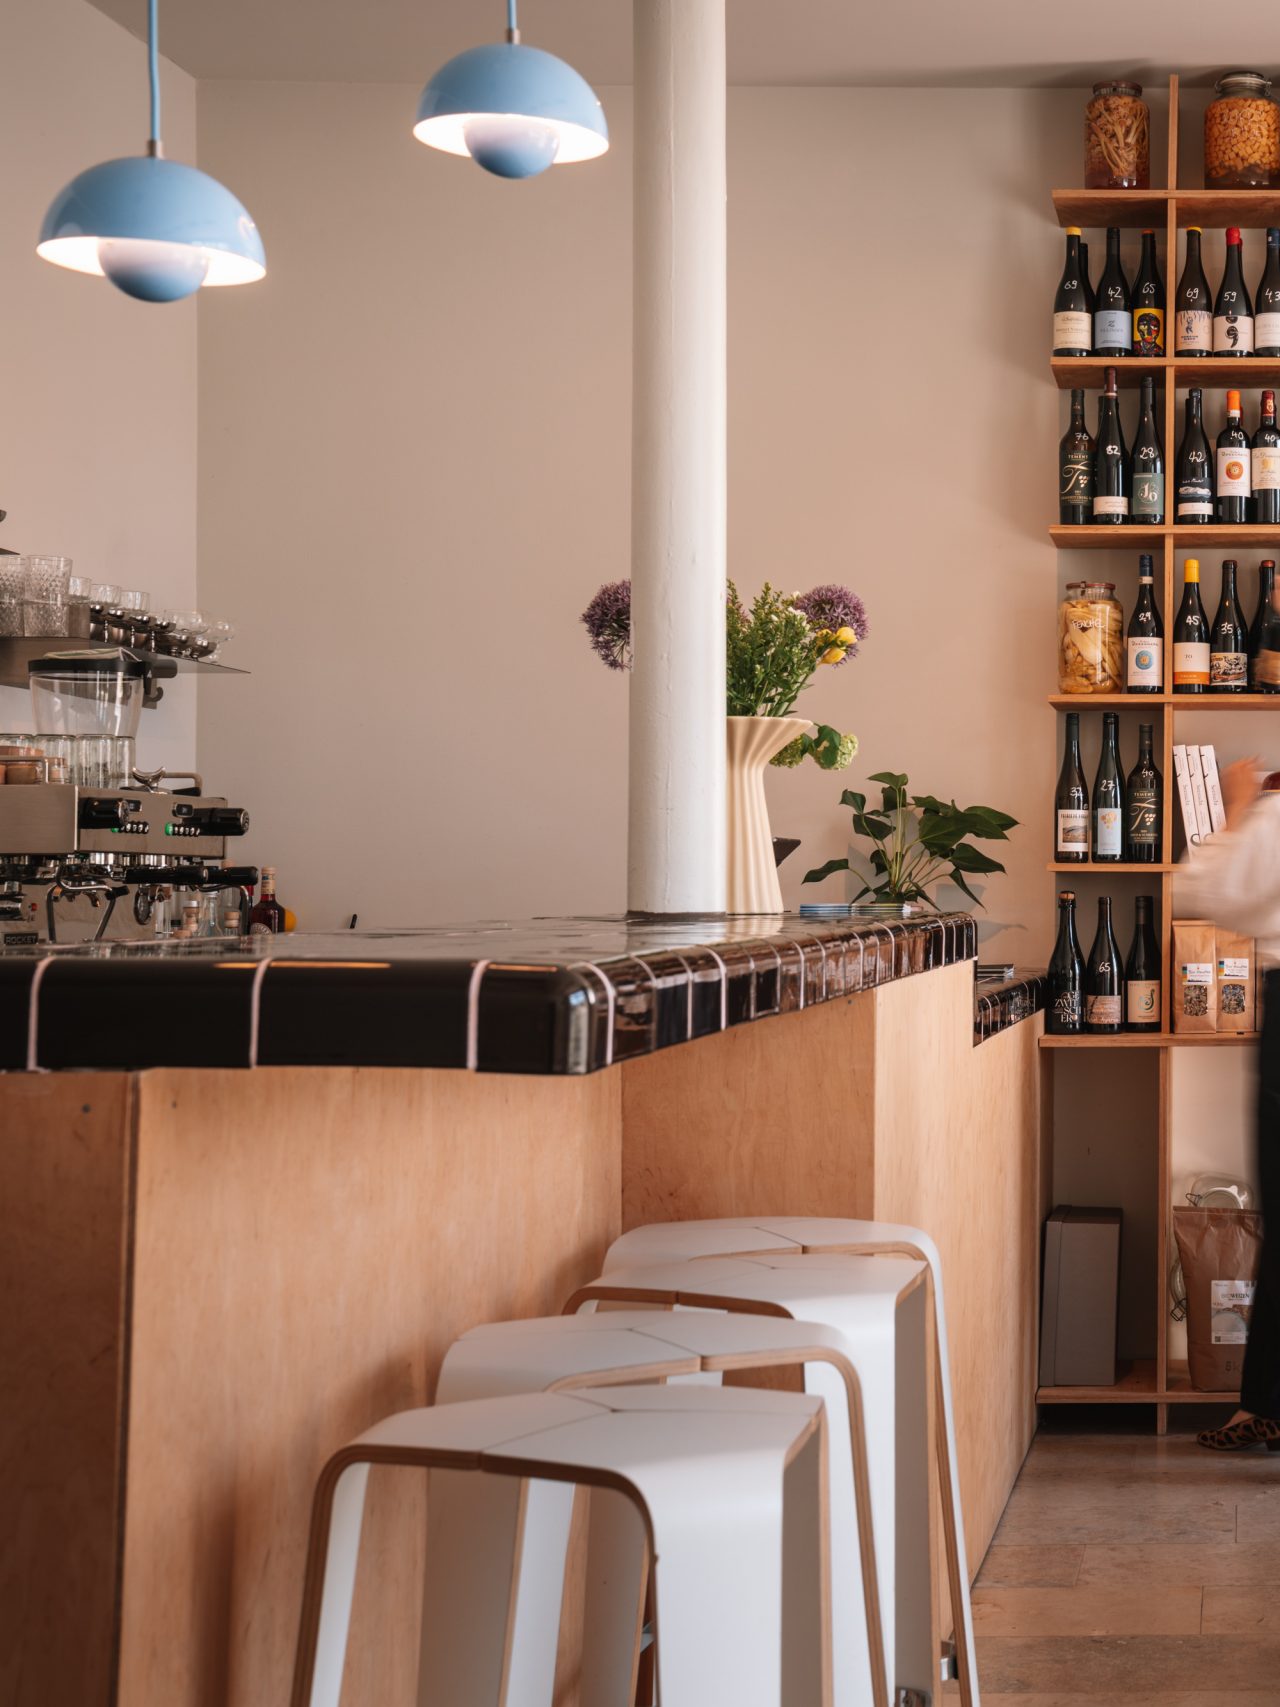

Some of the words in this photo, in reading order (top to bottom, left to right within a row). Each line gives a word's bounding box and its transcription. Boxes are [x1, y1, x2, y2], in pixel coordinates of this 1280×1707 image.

[1064, 280, 1078, 289] 69
[1142, 282, 1155, 294] 65
[1107, 286, 1122, 298] 42
[1186, 287, 1199, 299] 69
[1224, 291, 1237, 301] 59
[1265, 288, 1280, 301] 43
[1265, 433, 1276, 443] 40
[1140, 446, 1155, 459] 28
[1188, 451, 1205, 463] 42
[1139, 611, 1151, 622] 29
[1186, 615, 1200, 626] 45
[1221, 623, 1234, 634] 35
[1141, 768, 1154, 777] 40
[1100, 779, 1116, 791] 27
[5, 935, 36, 944] ROCKET
[1098, 962, 1111, 972] 65
